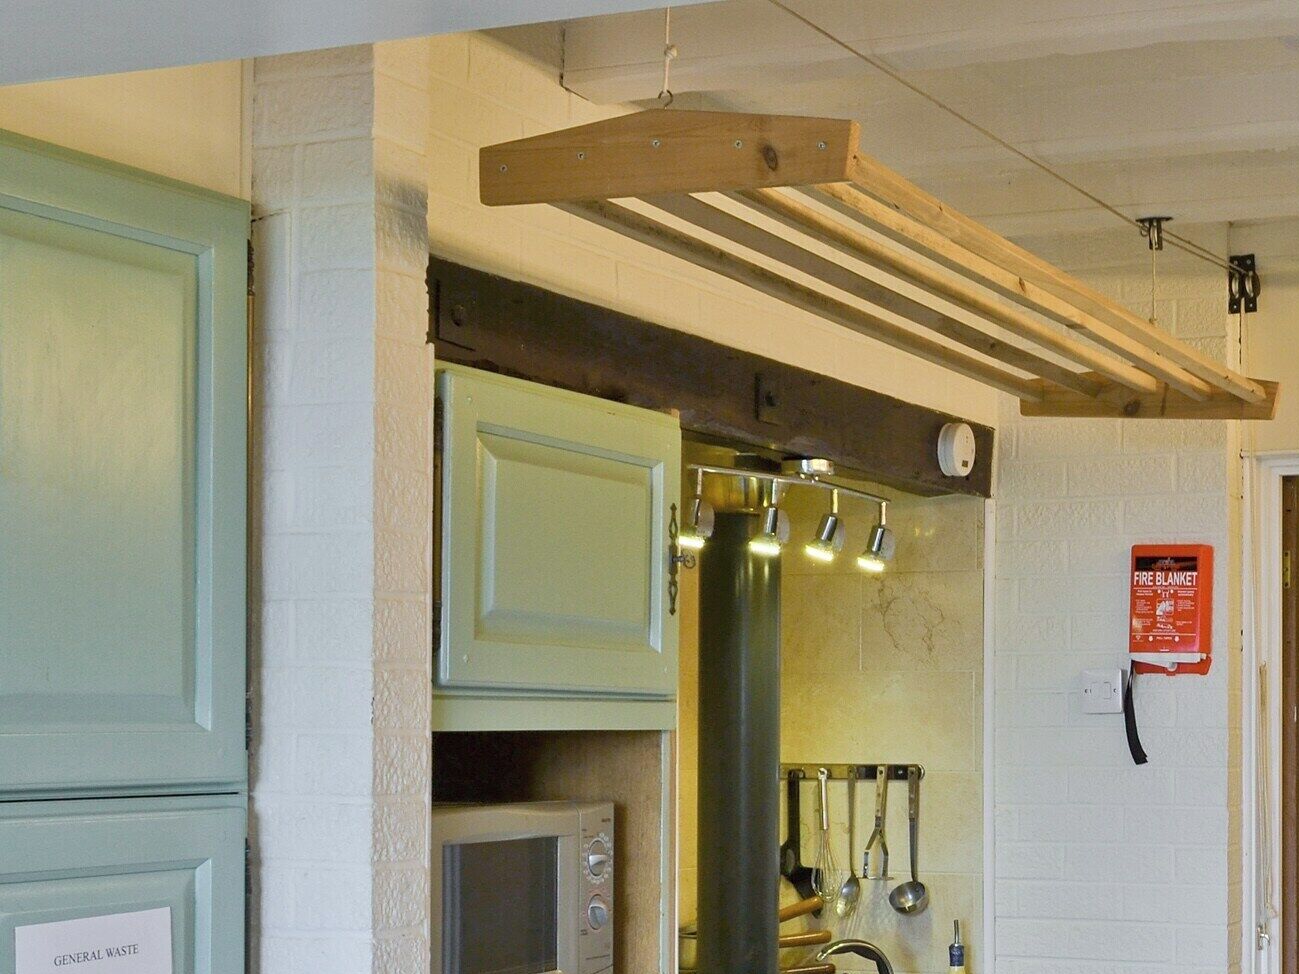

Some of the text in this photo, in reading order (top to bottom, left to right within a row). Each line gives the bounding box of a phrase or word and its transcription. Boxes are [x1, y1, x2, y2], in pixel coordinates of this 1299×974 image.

[1133, 571, 1198, 586] FIRE BLANKET
[54, 943, 139, 967] GENERAL WASTE
